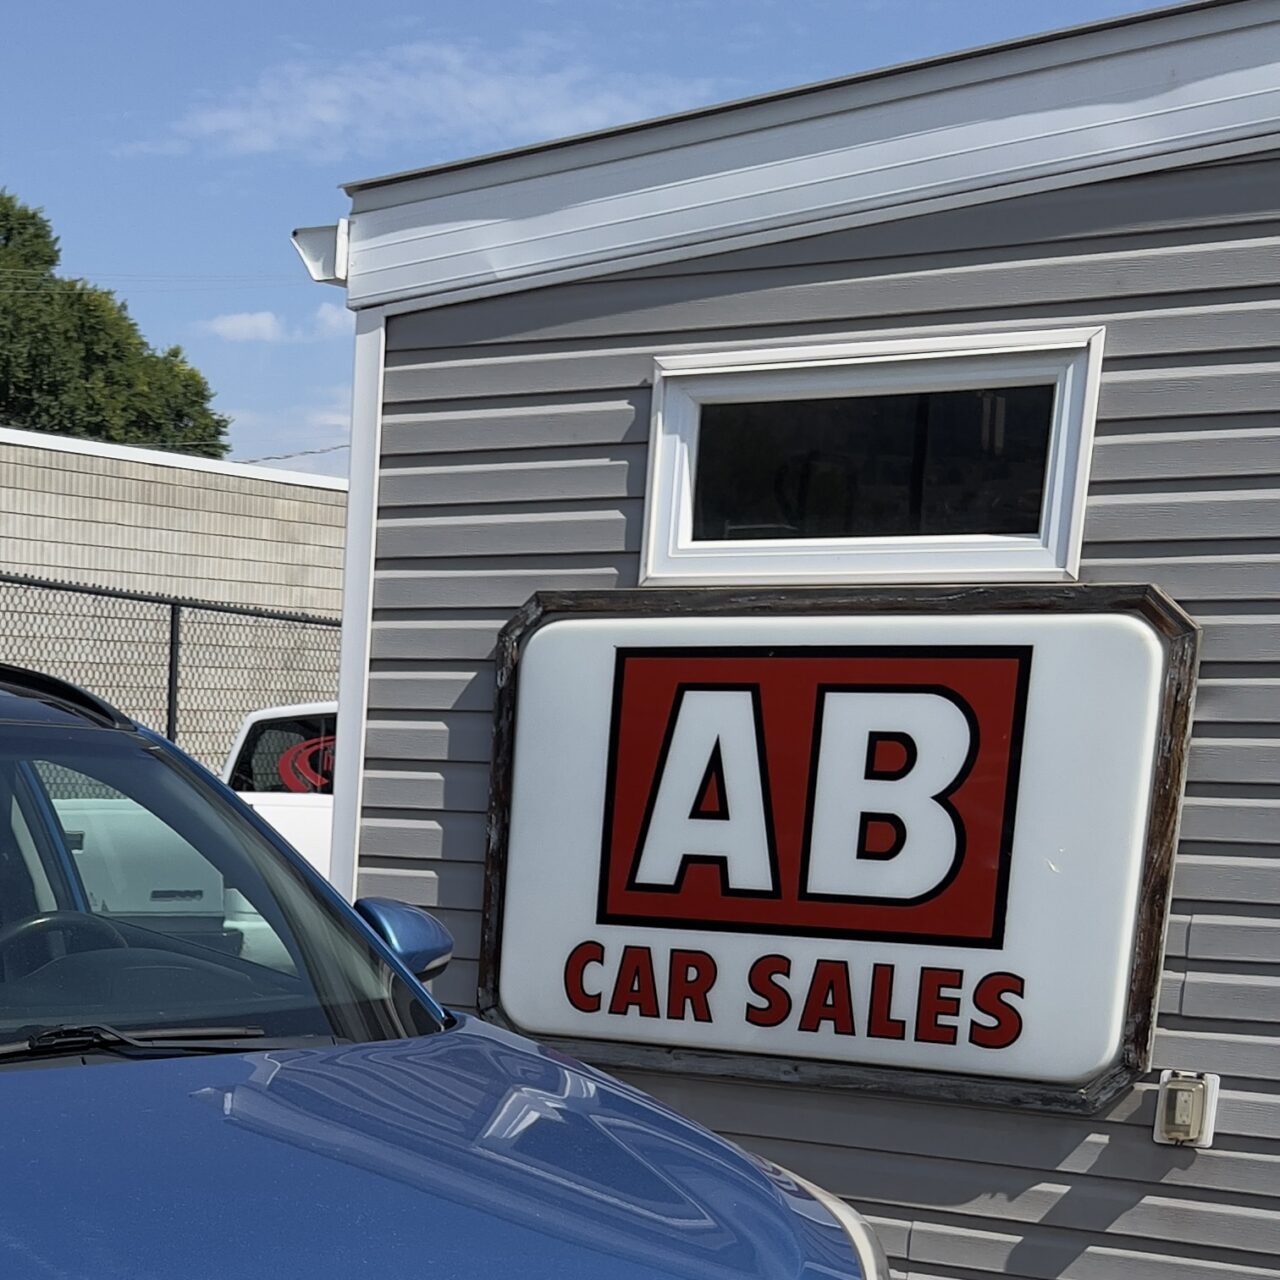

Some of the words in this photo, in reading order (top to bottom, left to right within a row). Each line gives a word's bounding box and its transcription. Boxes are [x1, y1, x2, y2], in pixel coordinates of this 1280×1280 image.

[629, 684, 977, 904] AB
[564, 940, 718, 1024] CAR
[744, 953, 1026, 1050] SALES
